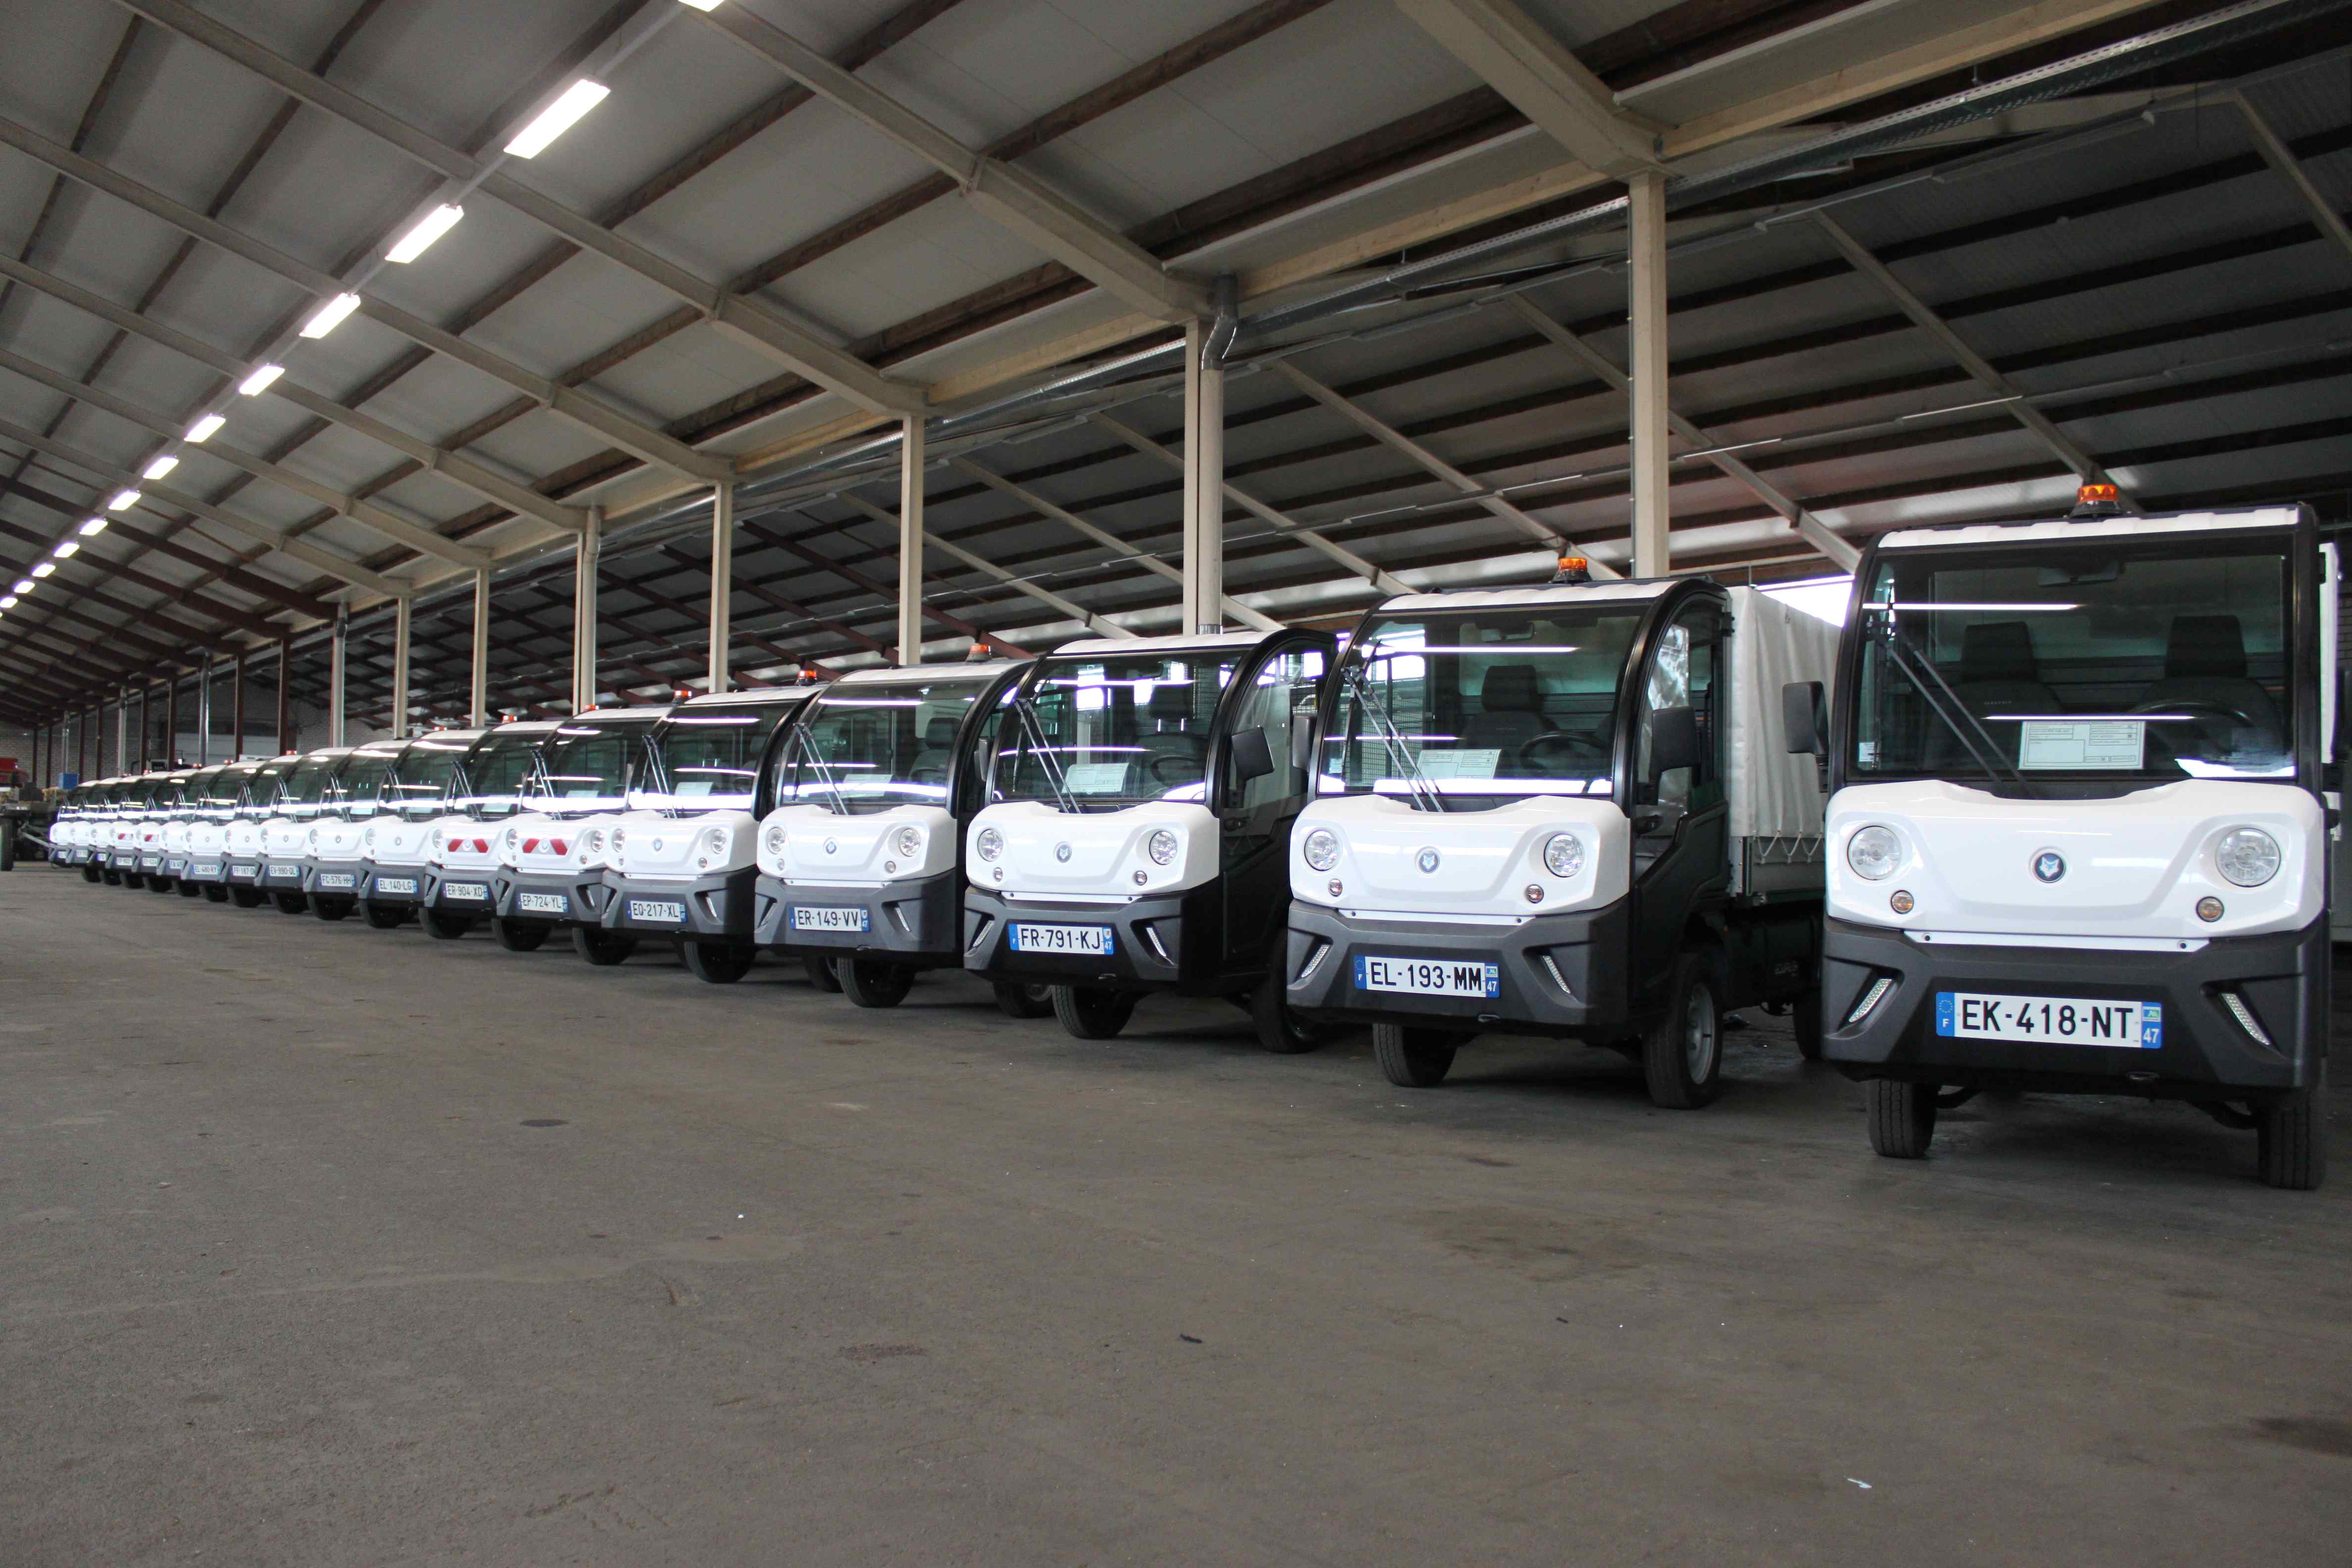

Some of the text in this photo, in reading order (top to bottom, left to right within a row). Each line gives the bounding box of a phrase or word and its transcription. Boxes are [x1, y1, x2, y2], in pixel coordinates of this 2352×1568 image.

[522, 895, 562, 908] EP-724-YL
[797, 910, 858, 927] ER-149-VV
[1021, 928, 1101, 950] FR-791-KJ
[1104, 941, 1112, 950] 47
[1371, 962, 1482, 991] EL-193-MM
[1487, 981, 1497, 991] 47
[1942, 1019, 1949, 1028] F
[1962, 999, 2133, 1039] EK-418-NT
[2143, 1028, 2159, 1043] 47
